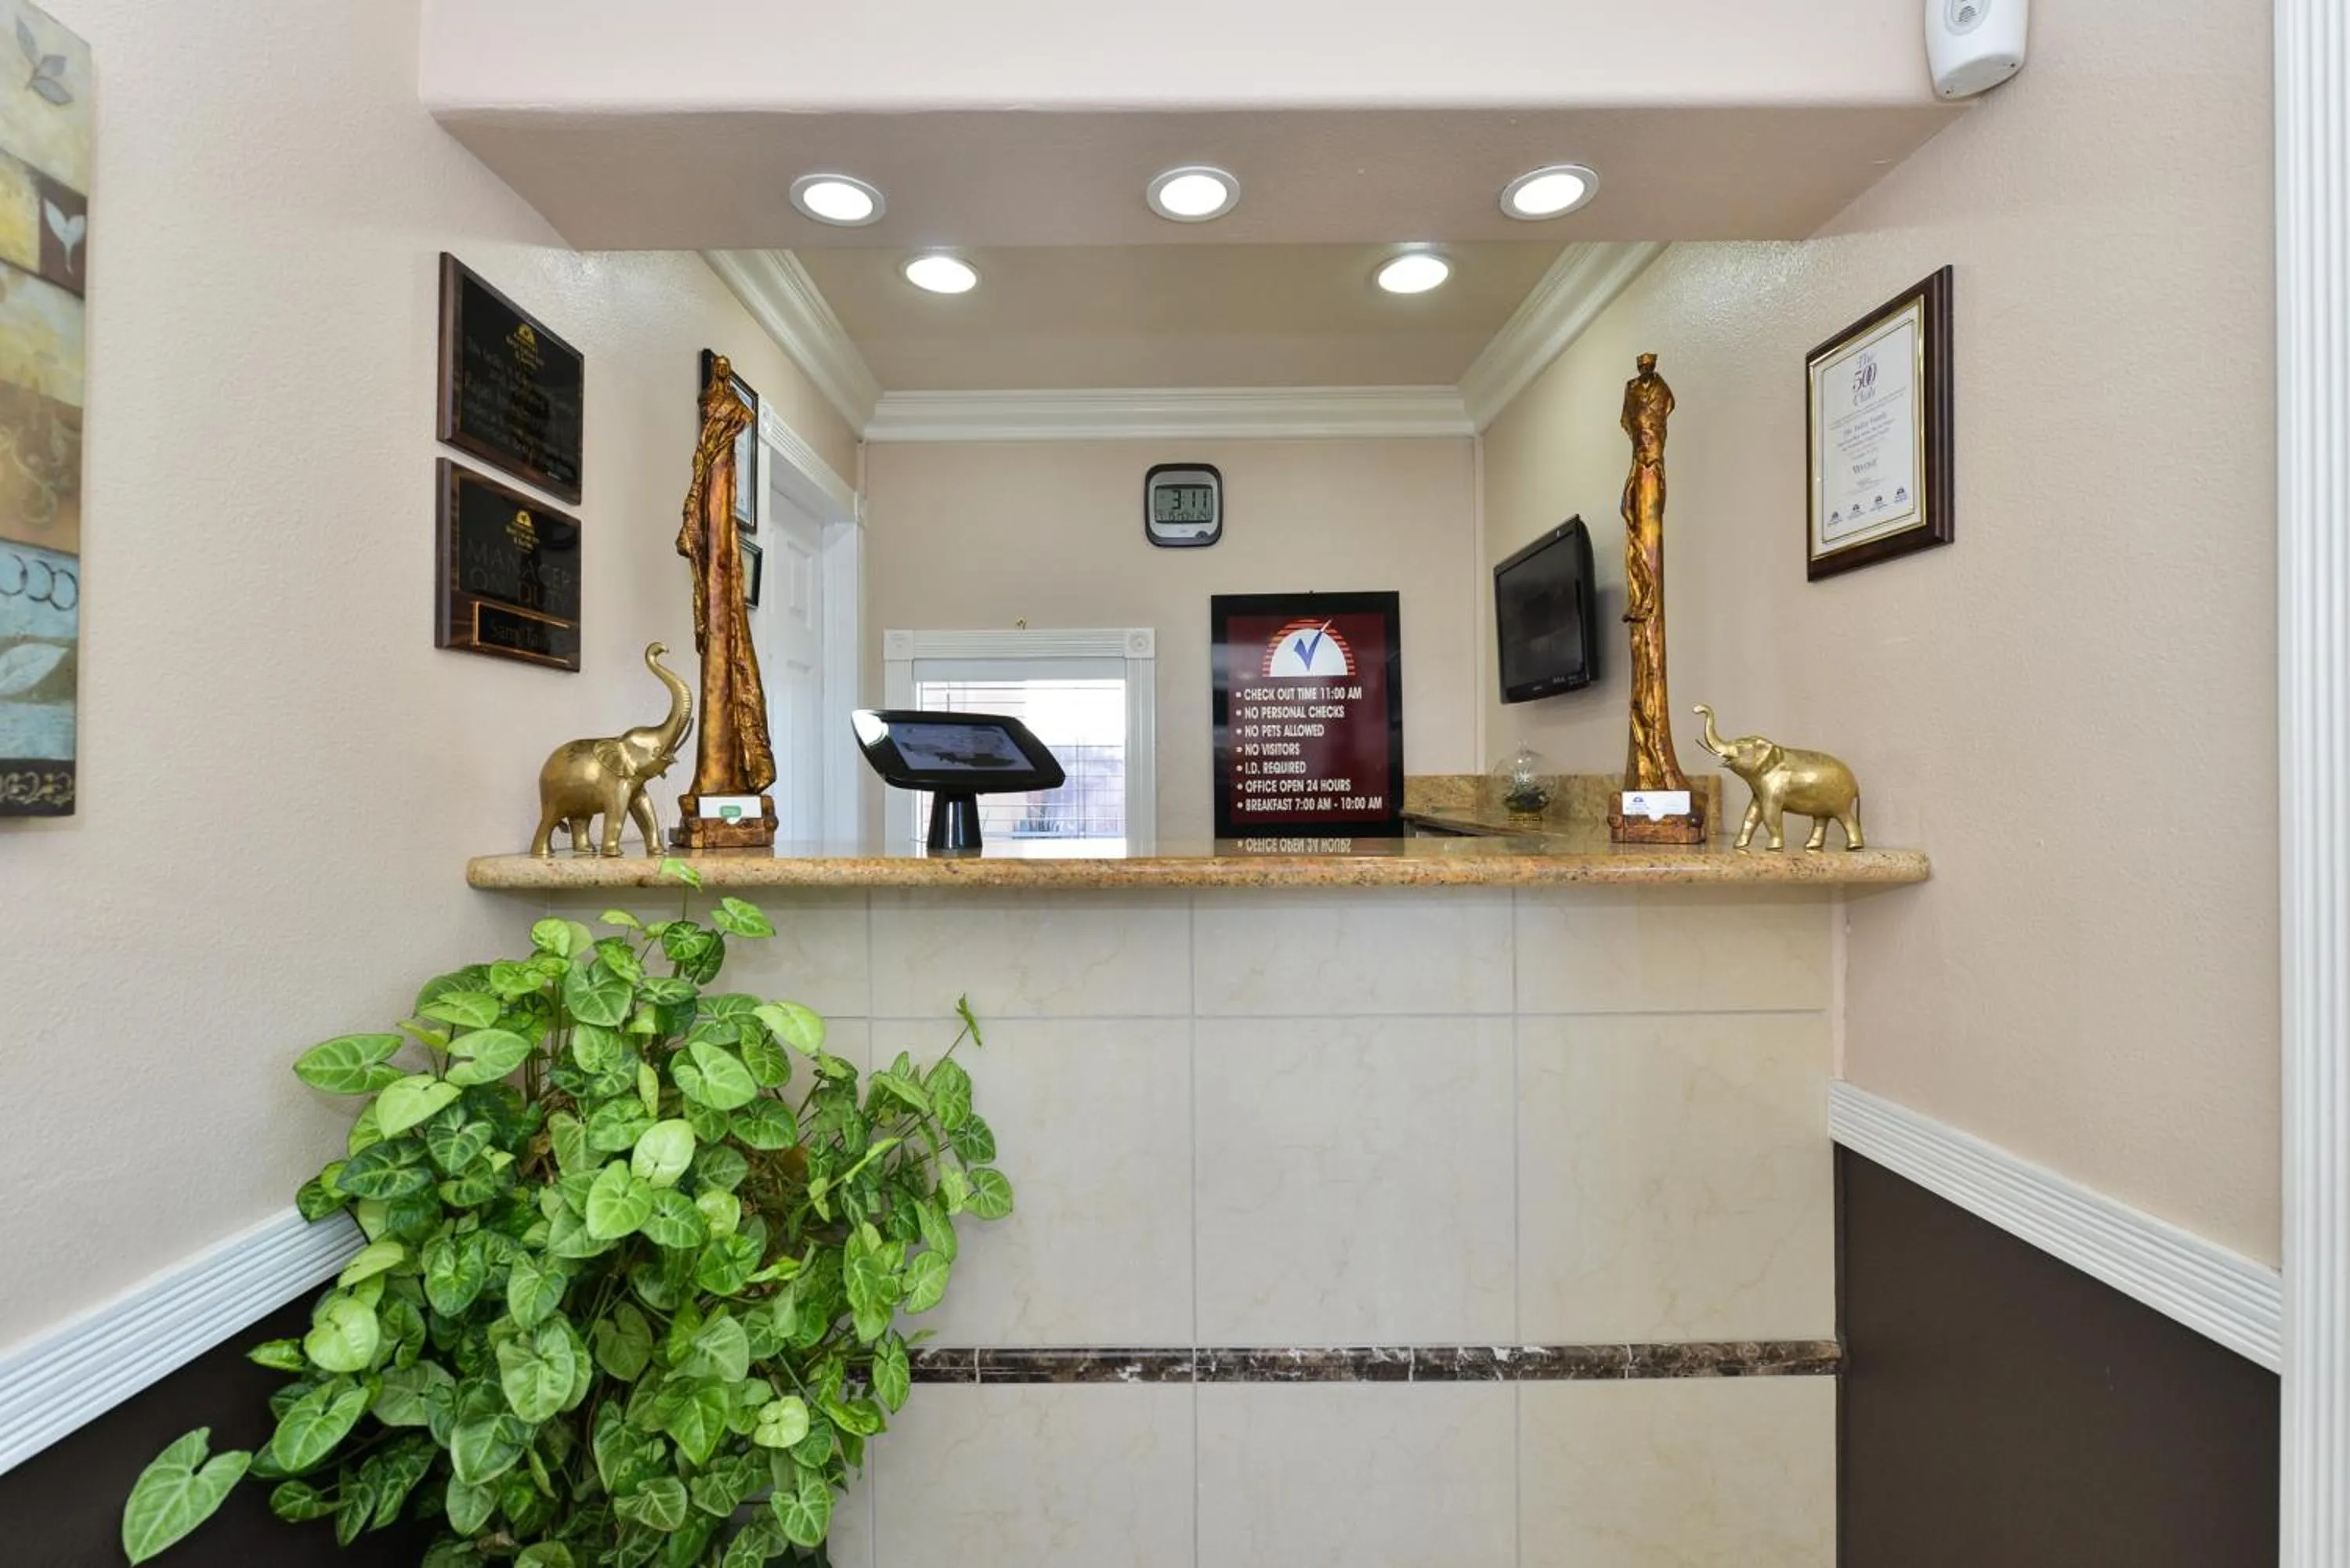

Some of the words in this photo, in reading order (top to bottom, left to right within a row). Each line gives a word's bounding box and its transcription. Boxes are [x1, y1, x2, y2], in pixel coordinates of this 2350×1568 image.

[1852, 363, 1878, 391] 500
[1244, 688, 1275, 701] CHECK
[1277, 687, 1295, 700] OUT
[1296, 686, 1317, 700] TIME
[1320, 686, 1345, 700] 11:00
[1347, 686, 1362, 699] AM
[1245, 706, 1259, 719] NO
[1261, 706, 1307, 718] PERSONAL
[1308, 706, 1345, 718] CHECKS
[1245, 724, 1259, 737] NO
[1261, 724, 1282, 737] PETS
[1284, 724, 1325, 737] ALLOWED
[1245, 742, 1260, 756] NO
[1262, 742, 1300, 756] VISITORS
[1245, 761, 1260, 775] I.D.
[1263, 761, 1307, 774] REQUIRED
[1245, 779, 1278, 793] OFFICE
[1279, 779, 1304, 793] OPEN
[1307, 779, 1318, 792] 24
[1320, 779, 1351, 793] HOURS
[1246, 797, 1292, 811] BREAKFAST
[1295, 797, 1316, 810] 7:00
[1317, 797, 1332, 811] AM
[1341, 797, 1366, 810] 10:00
[1368, 796, 1383, 810] AM
